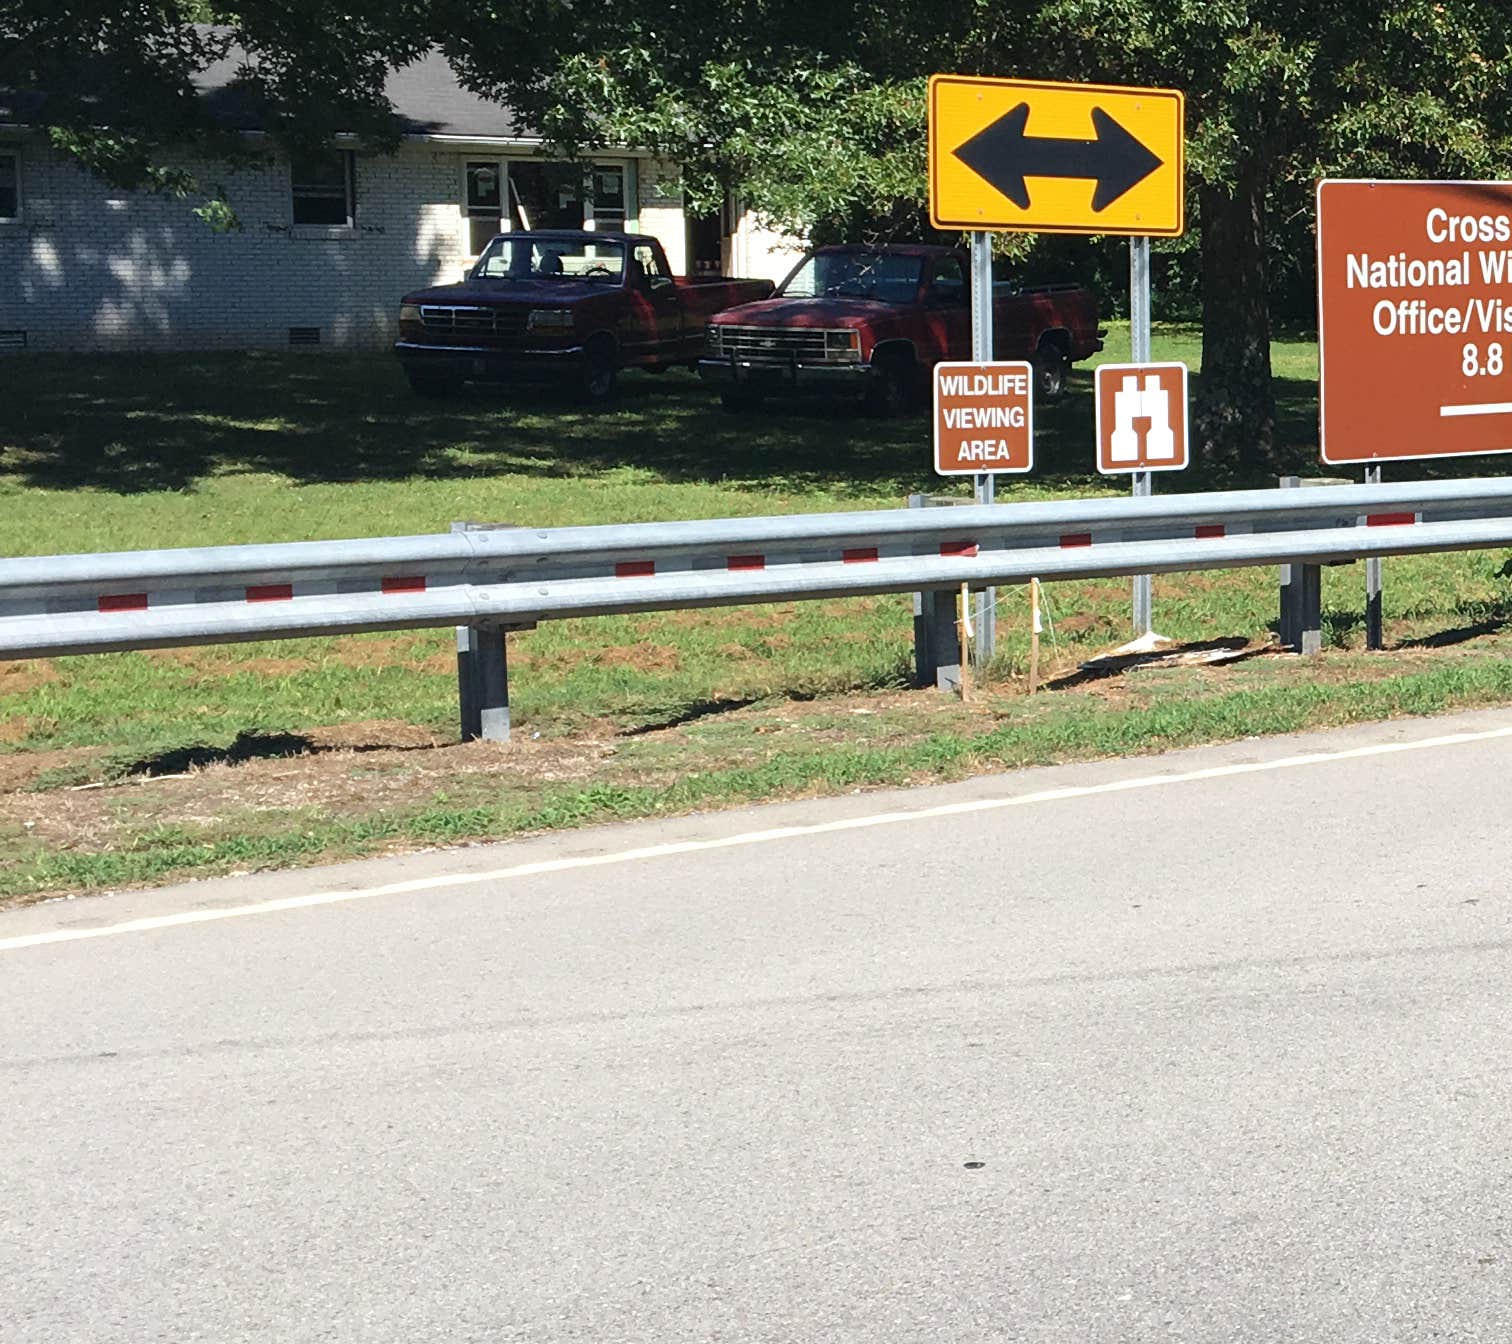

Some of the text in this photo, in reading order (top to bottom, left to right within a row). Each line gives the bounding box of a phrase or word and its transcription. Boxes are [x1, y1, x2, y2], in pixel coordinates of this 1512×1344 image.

[1426, 208, 1510, 243] Cross
[1346, 251, 1470, 289] National
[1462, 342, 1504, 377] 8.8
[939, 375, 1027, 396] WILDLIFE
[943, 407, 1025, 430] VIEWING
[957, 440, 1010, 461] AREA
